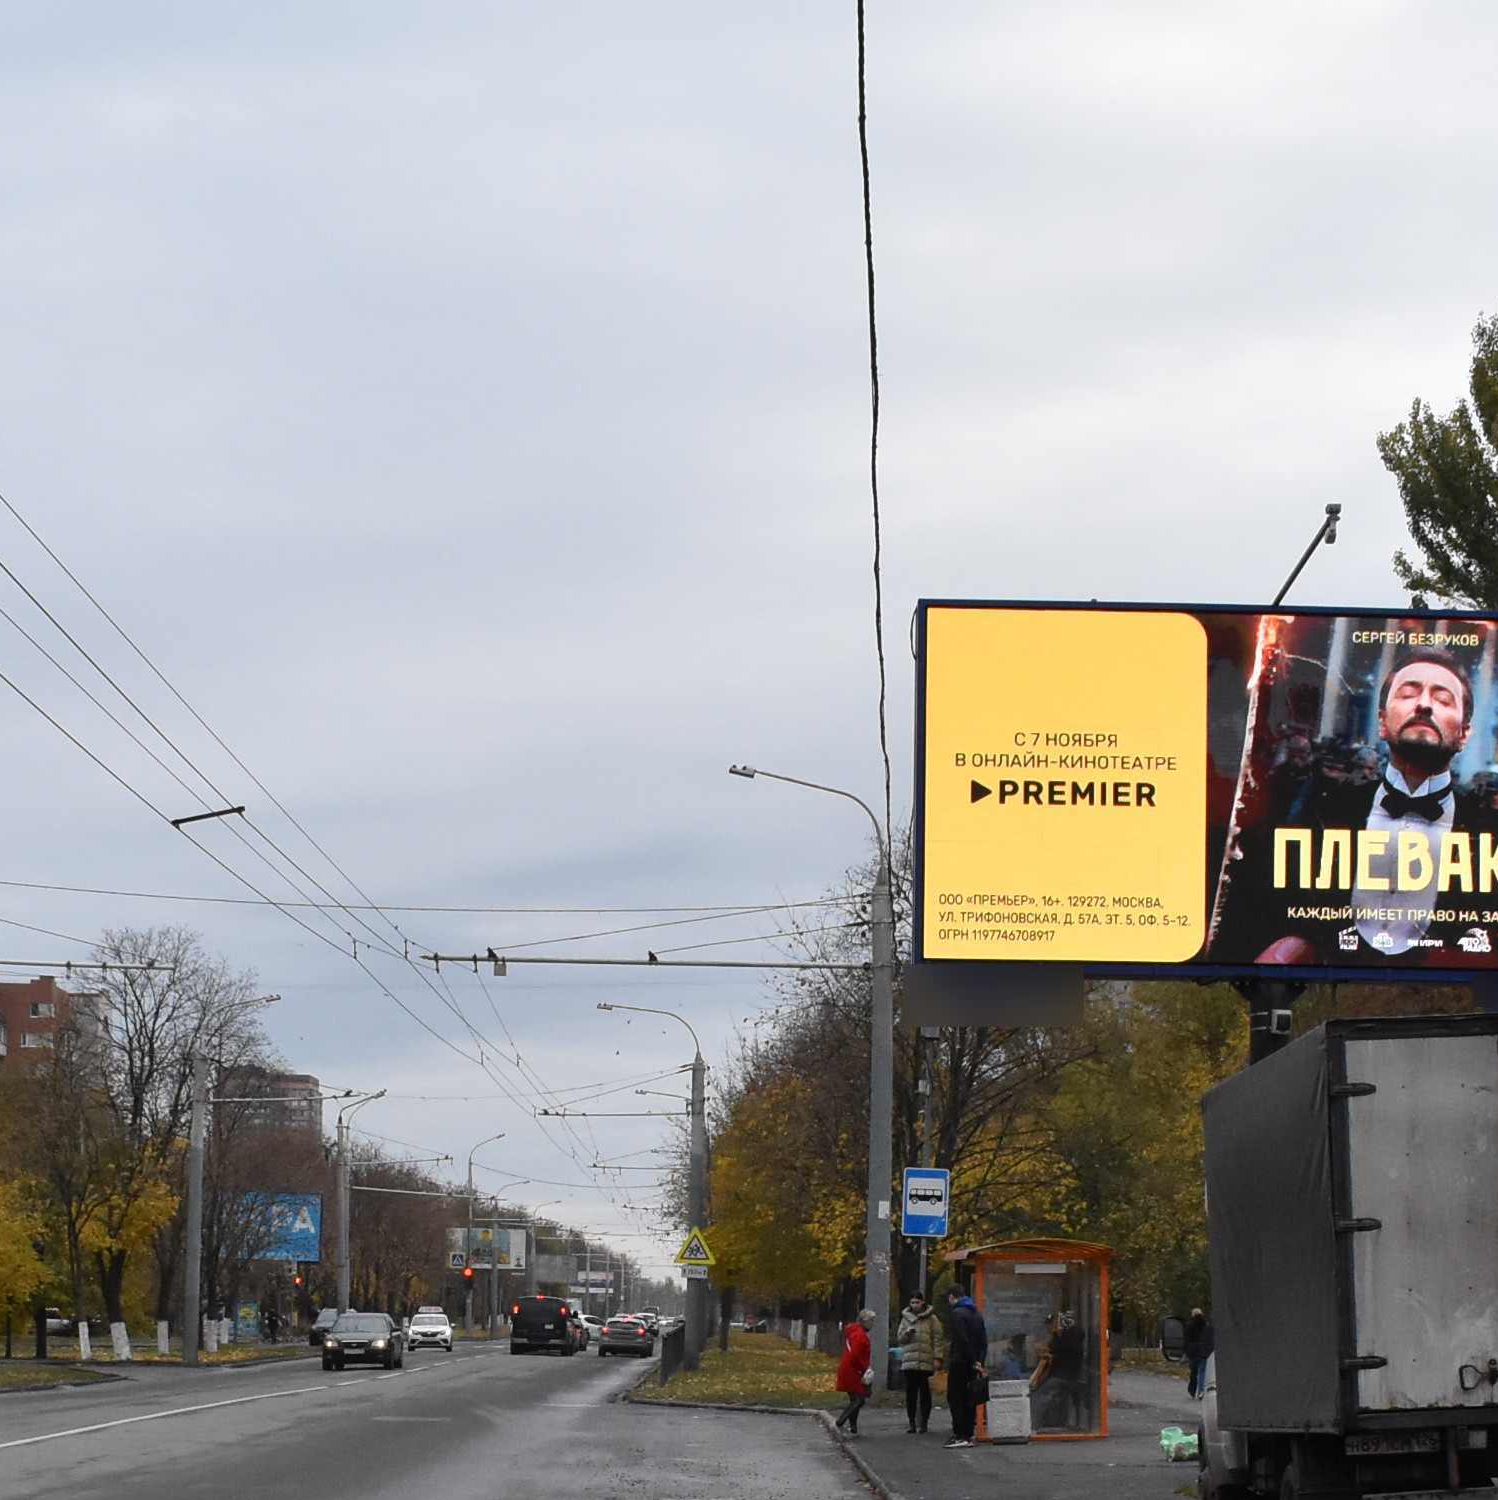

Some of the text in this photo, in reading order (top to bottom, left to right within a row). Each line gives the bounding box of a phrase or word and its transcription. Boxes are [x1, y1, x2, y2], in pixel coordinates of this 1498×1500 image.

[1352, 630, 1479, 647] СЕРГЕЙ БЕЗРУКОВ
[1014, 732, 1118, 748] С 7 НОЯБРЯ
[955, 751, 1177, 771] В ОНЛАЙН-КИНОТЕАТРЕ
[998, 779, 1157, 807] PREMIER
[938, 893, 963, 905] ООО
[1287, 905, 1353, 920] КАЖДЫЙ
[1356, 908, 1403, 920] ИМЕЕТ
[1407, 909, 1455, 922] ПРАВО
[1459, 911, 1479, 922] НА
[938, 928, 1056, 942] ОГРН 1197746708917
